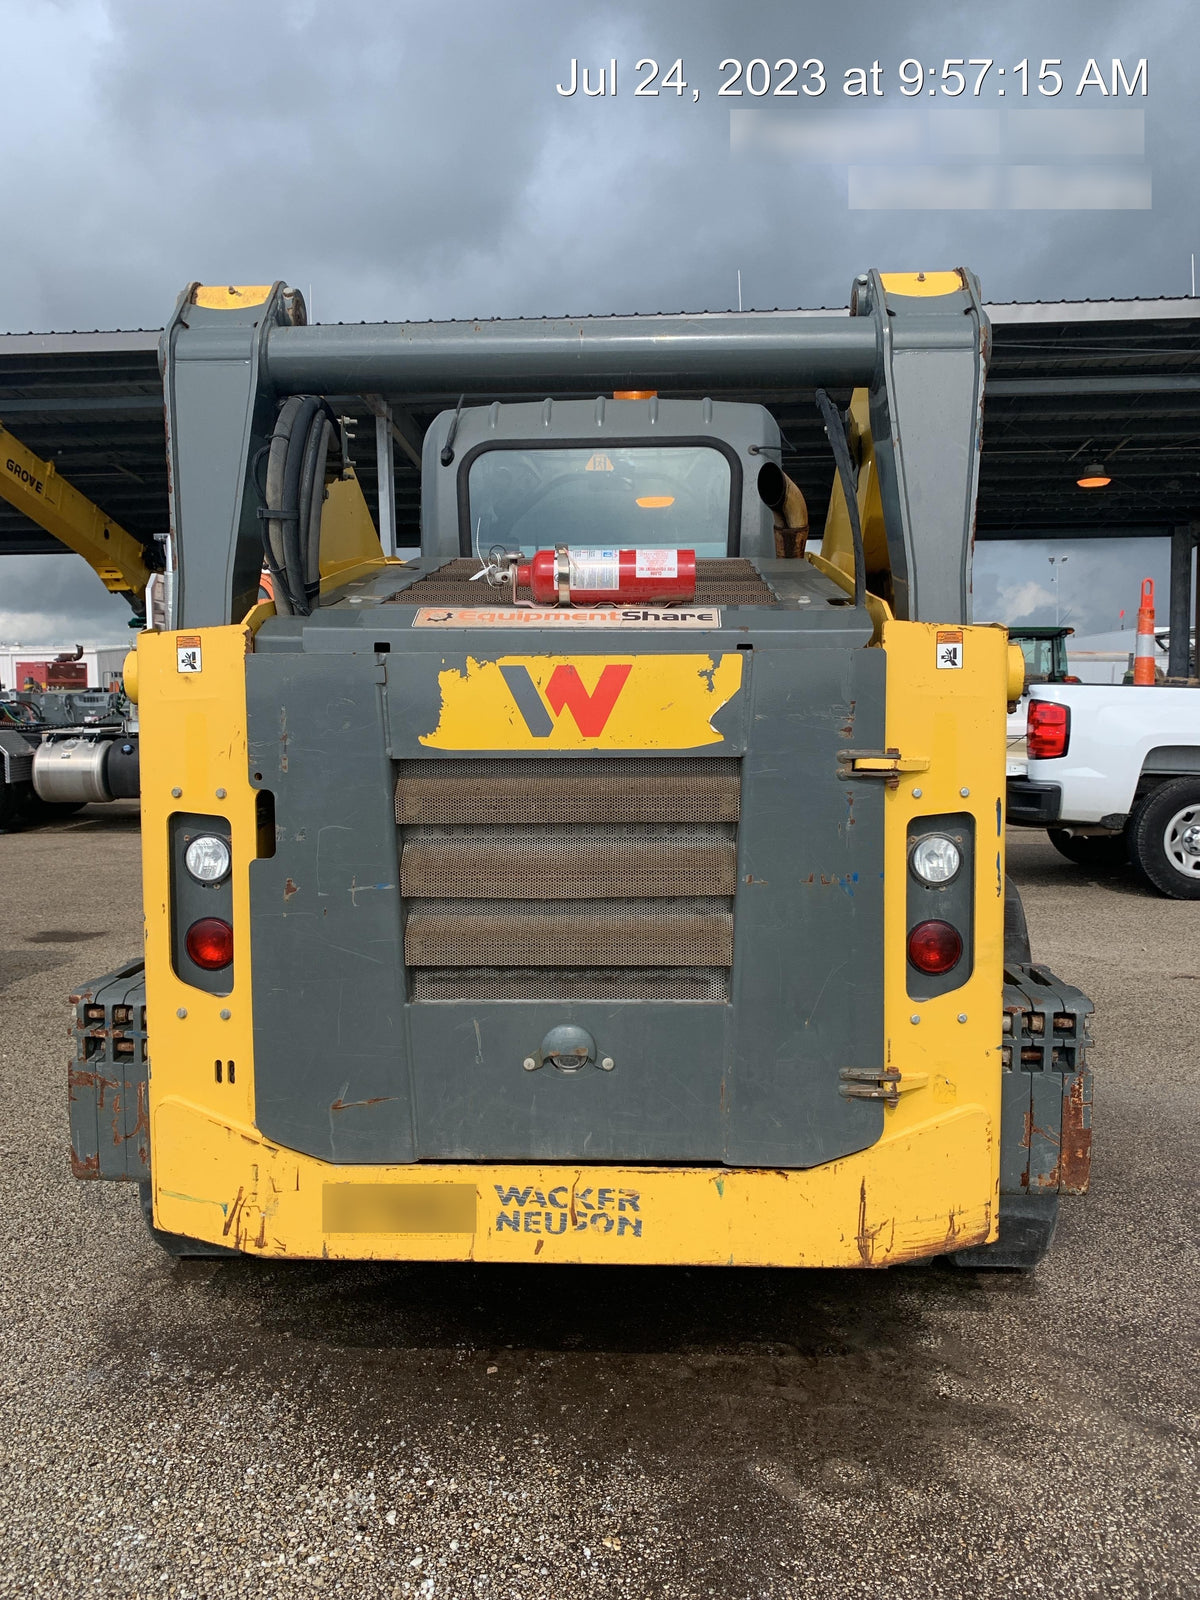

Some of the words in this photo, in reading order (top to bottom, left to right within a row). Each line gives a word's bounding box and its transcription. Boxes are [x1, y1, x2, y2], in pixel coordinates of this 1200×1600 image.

[6, 459, 43, 494] GROVE
[457, 610, 714, 625] EquipmentShare
[494, 1184, 641, 1212] WACKER
[495, 1210, 643, 1237] NEUSON
